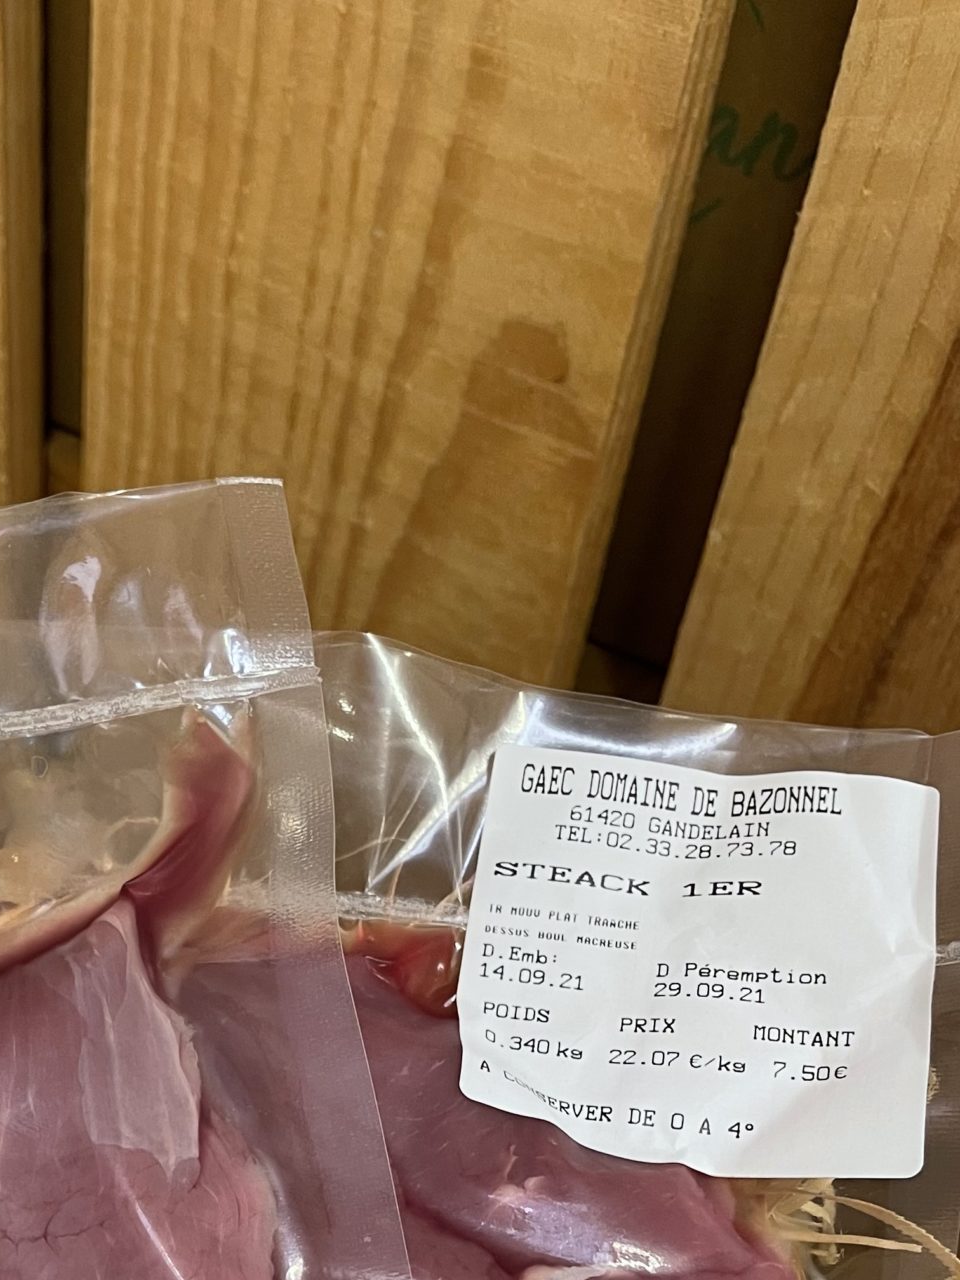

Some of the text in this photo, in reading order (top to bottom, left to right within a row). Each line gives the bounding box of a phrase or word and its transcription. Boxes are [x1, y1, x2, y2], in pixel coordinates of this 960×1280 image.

[521, 764, 843, 817] GAEC DOMAINE DE BAZONNEL
[570, 805, 771, 840] 61420 GANDELAIN
[494, 861, 763, 897] STEACK 1ER
[484, 925, 529, 938] DESSUS
[576, 936, 638, 950] MACREUSE
[479, 962, 584, 991] 14.09.21
[656, 961, 828, 986] D Péremption
[654, 982, 766, 1005] 29.09.21
[483, 1001, 550, 1024] POIDS
[620, 1017, 676, 1034] PRIX
[753, 1025, 856, 1048] MONTANT
[608, 1049, 680, 1067] 22.07
[773, 1061, 848, 1083] 7.50€
[480, 1060, 491, 1073] A
[628, 1108, 656, 1127] DE
[699, 1118, 711, 1135] A
